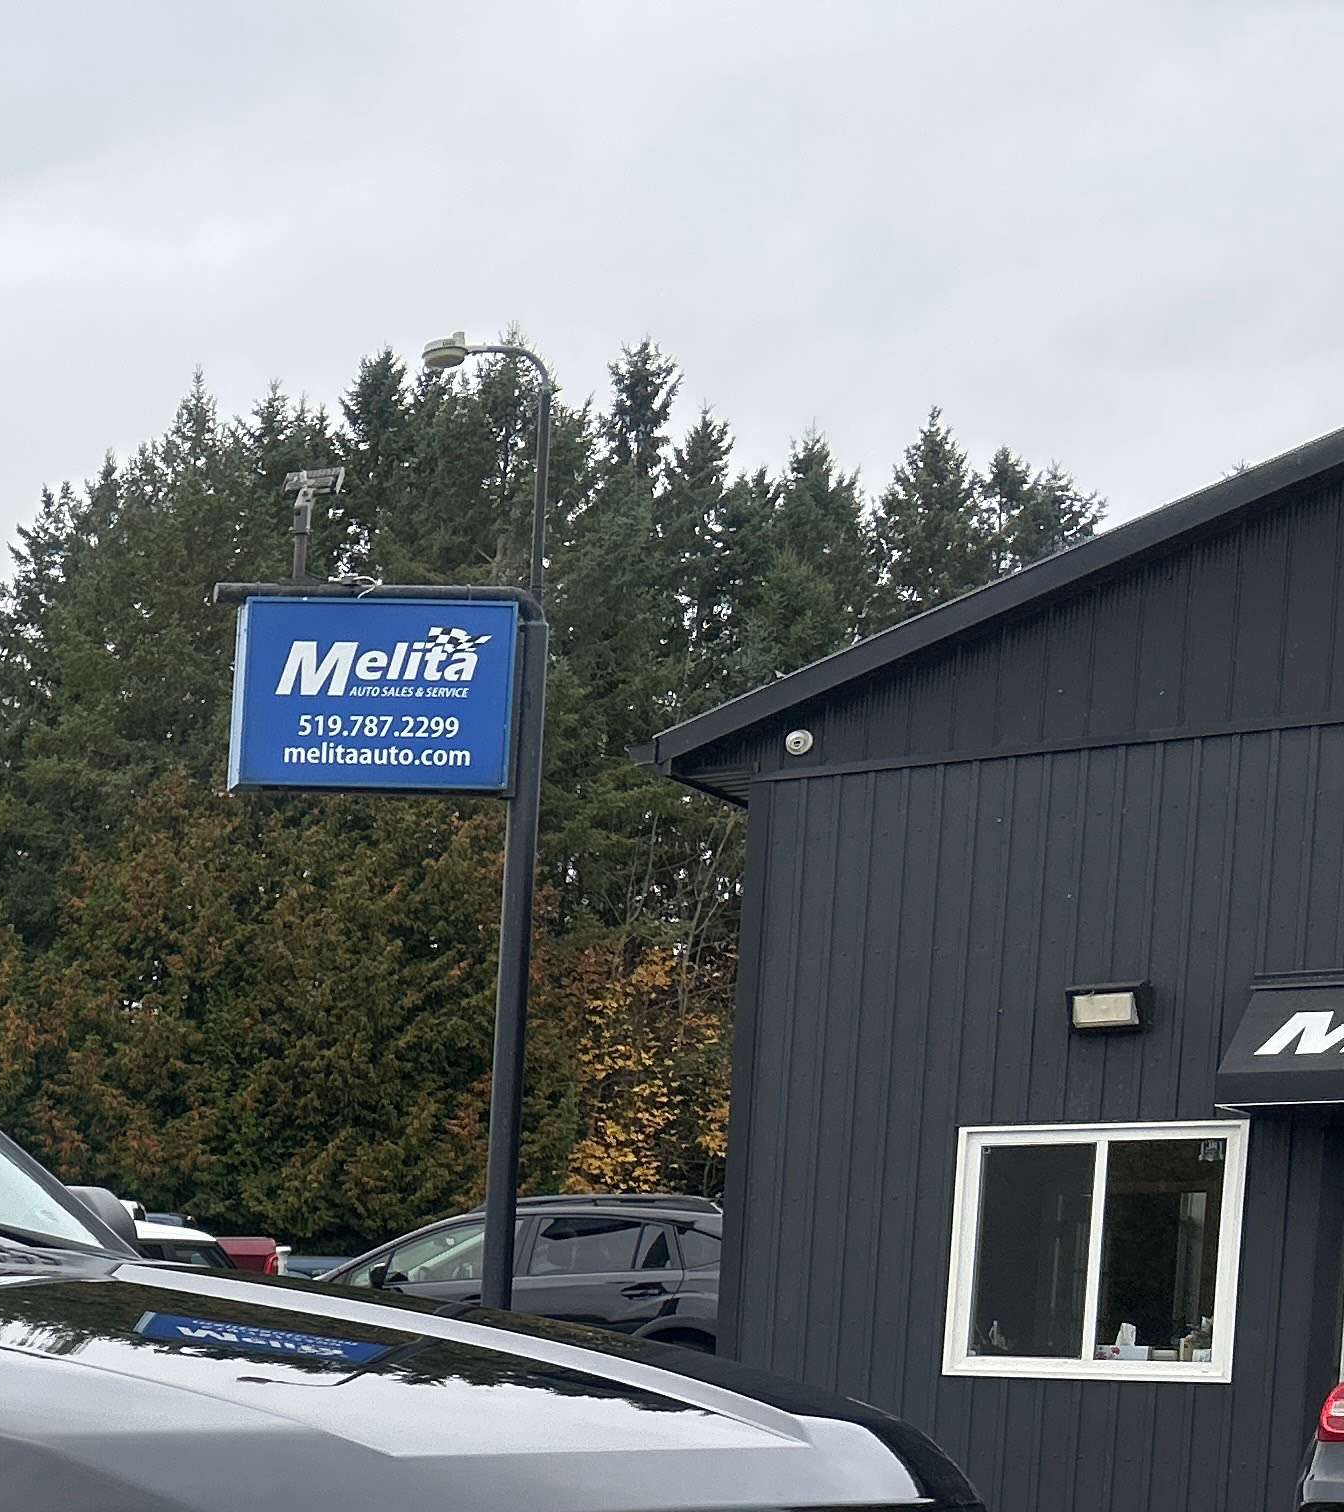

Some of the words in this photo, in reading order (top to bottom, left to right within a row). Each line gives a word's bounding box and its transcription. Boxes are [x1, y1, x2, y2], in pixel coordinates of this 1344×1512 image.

[275, 639, 480, 697] Melita
[349, 686, 380, 697] AUTO
[381, 686, 414, 697] SALES
[415, 687, 424, 697] &
[426, 687, 470, 698] SERVICE
[297, 714, 460, 738] 519.787.2299
[282, 741, 471, 767] melitaauto.com
